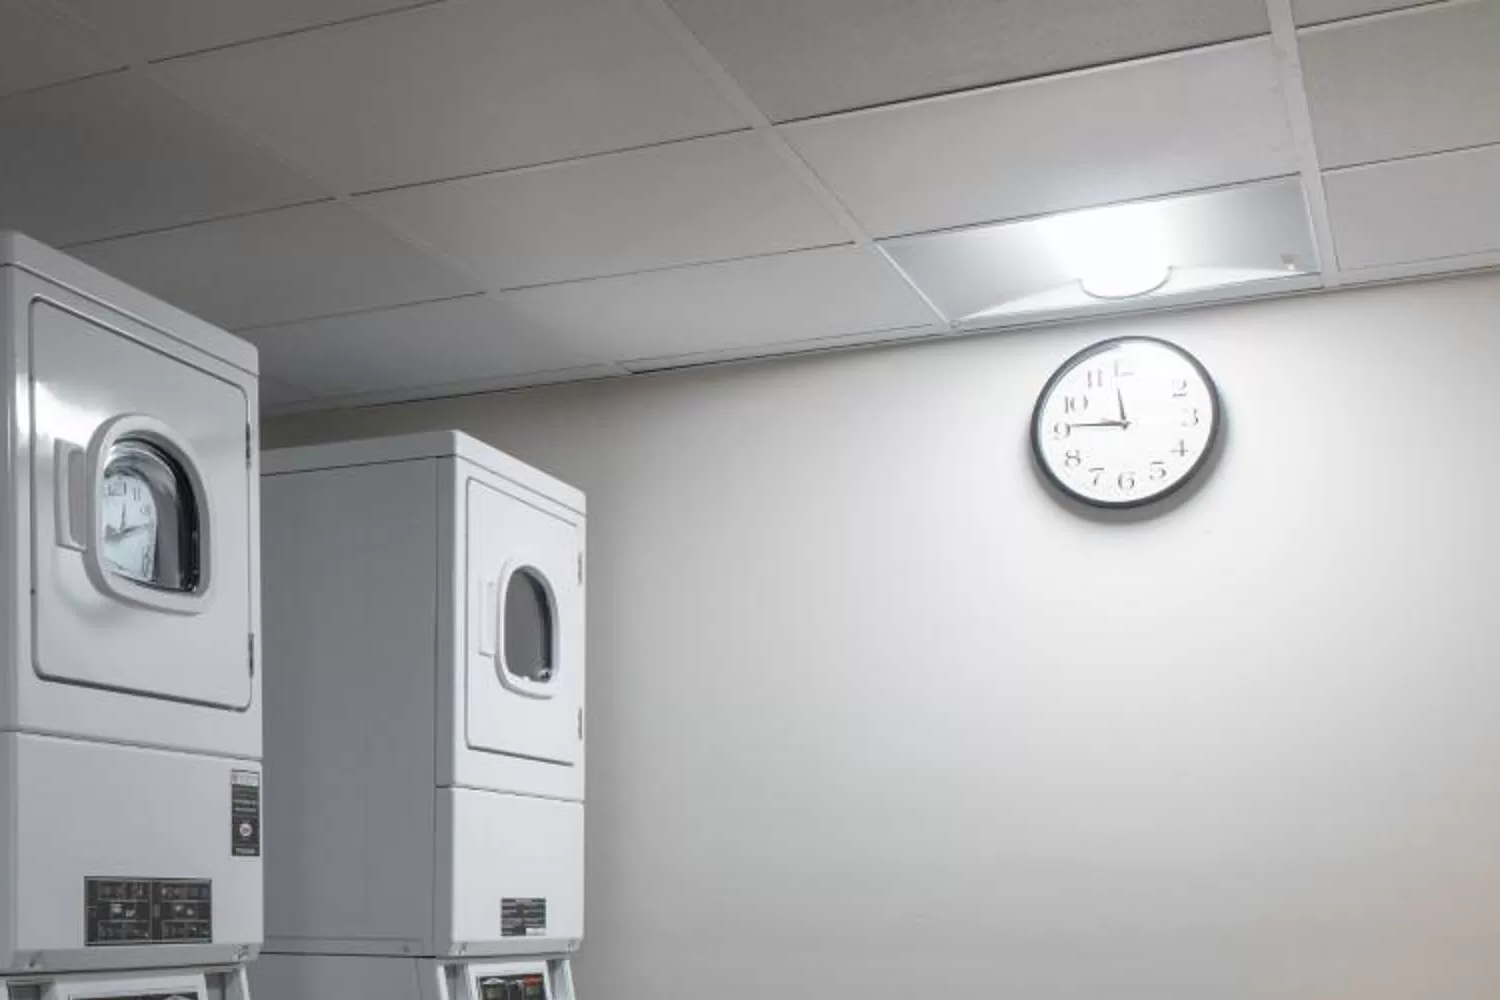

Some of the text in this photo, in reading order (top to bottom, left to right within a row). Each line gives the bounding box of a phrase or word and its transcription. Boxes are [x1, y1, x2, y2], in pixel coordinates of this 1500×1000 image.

[1087, 368, 1104, 388] 11
[1172, 379, 1188, 398] 2
[1064, 395, 1089, 414] 10
[1181, 408, 1199, 427] 3
[1053, 421, 1071, 440] 9
[1064, 449, 1081, 467] 8
[1088, 466, 1105, 486] 7
[1149, 461, 1168, 480] 5
[1117, 471, 1136, 490] 6
